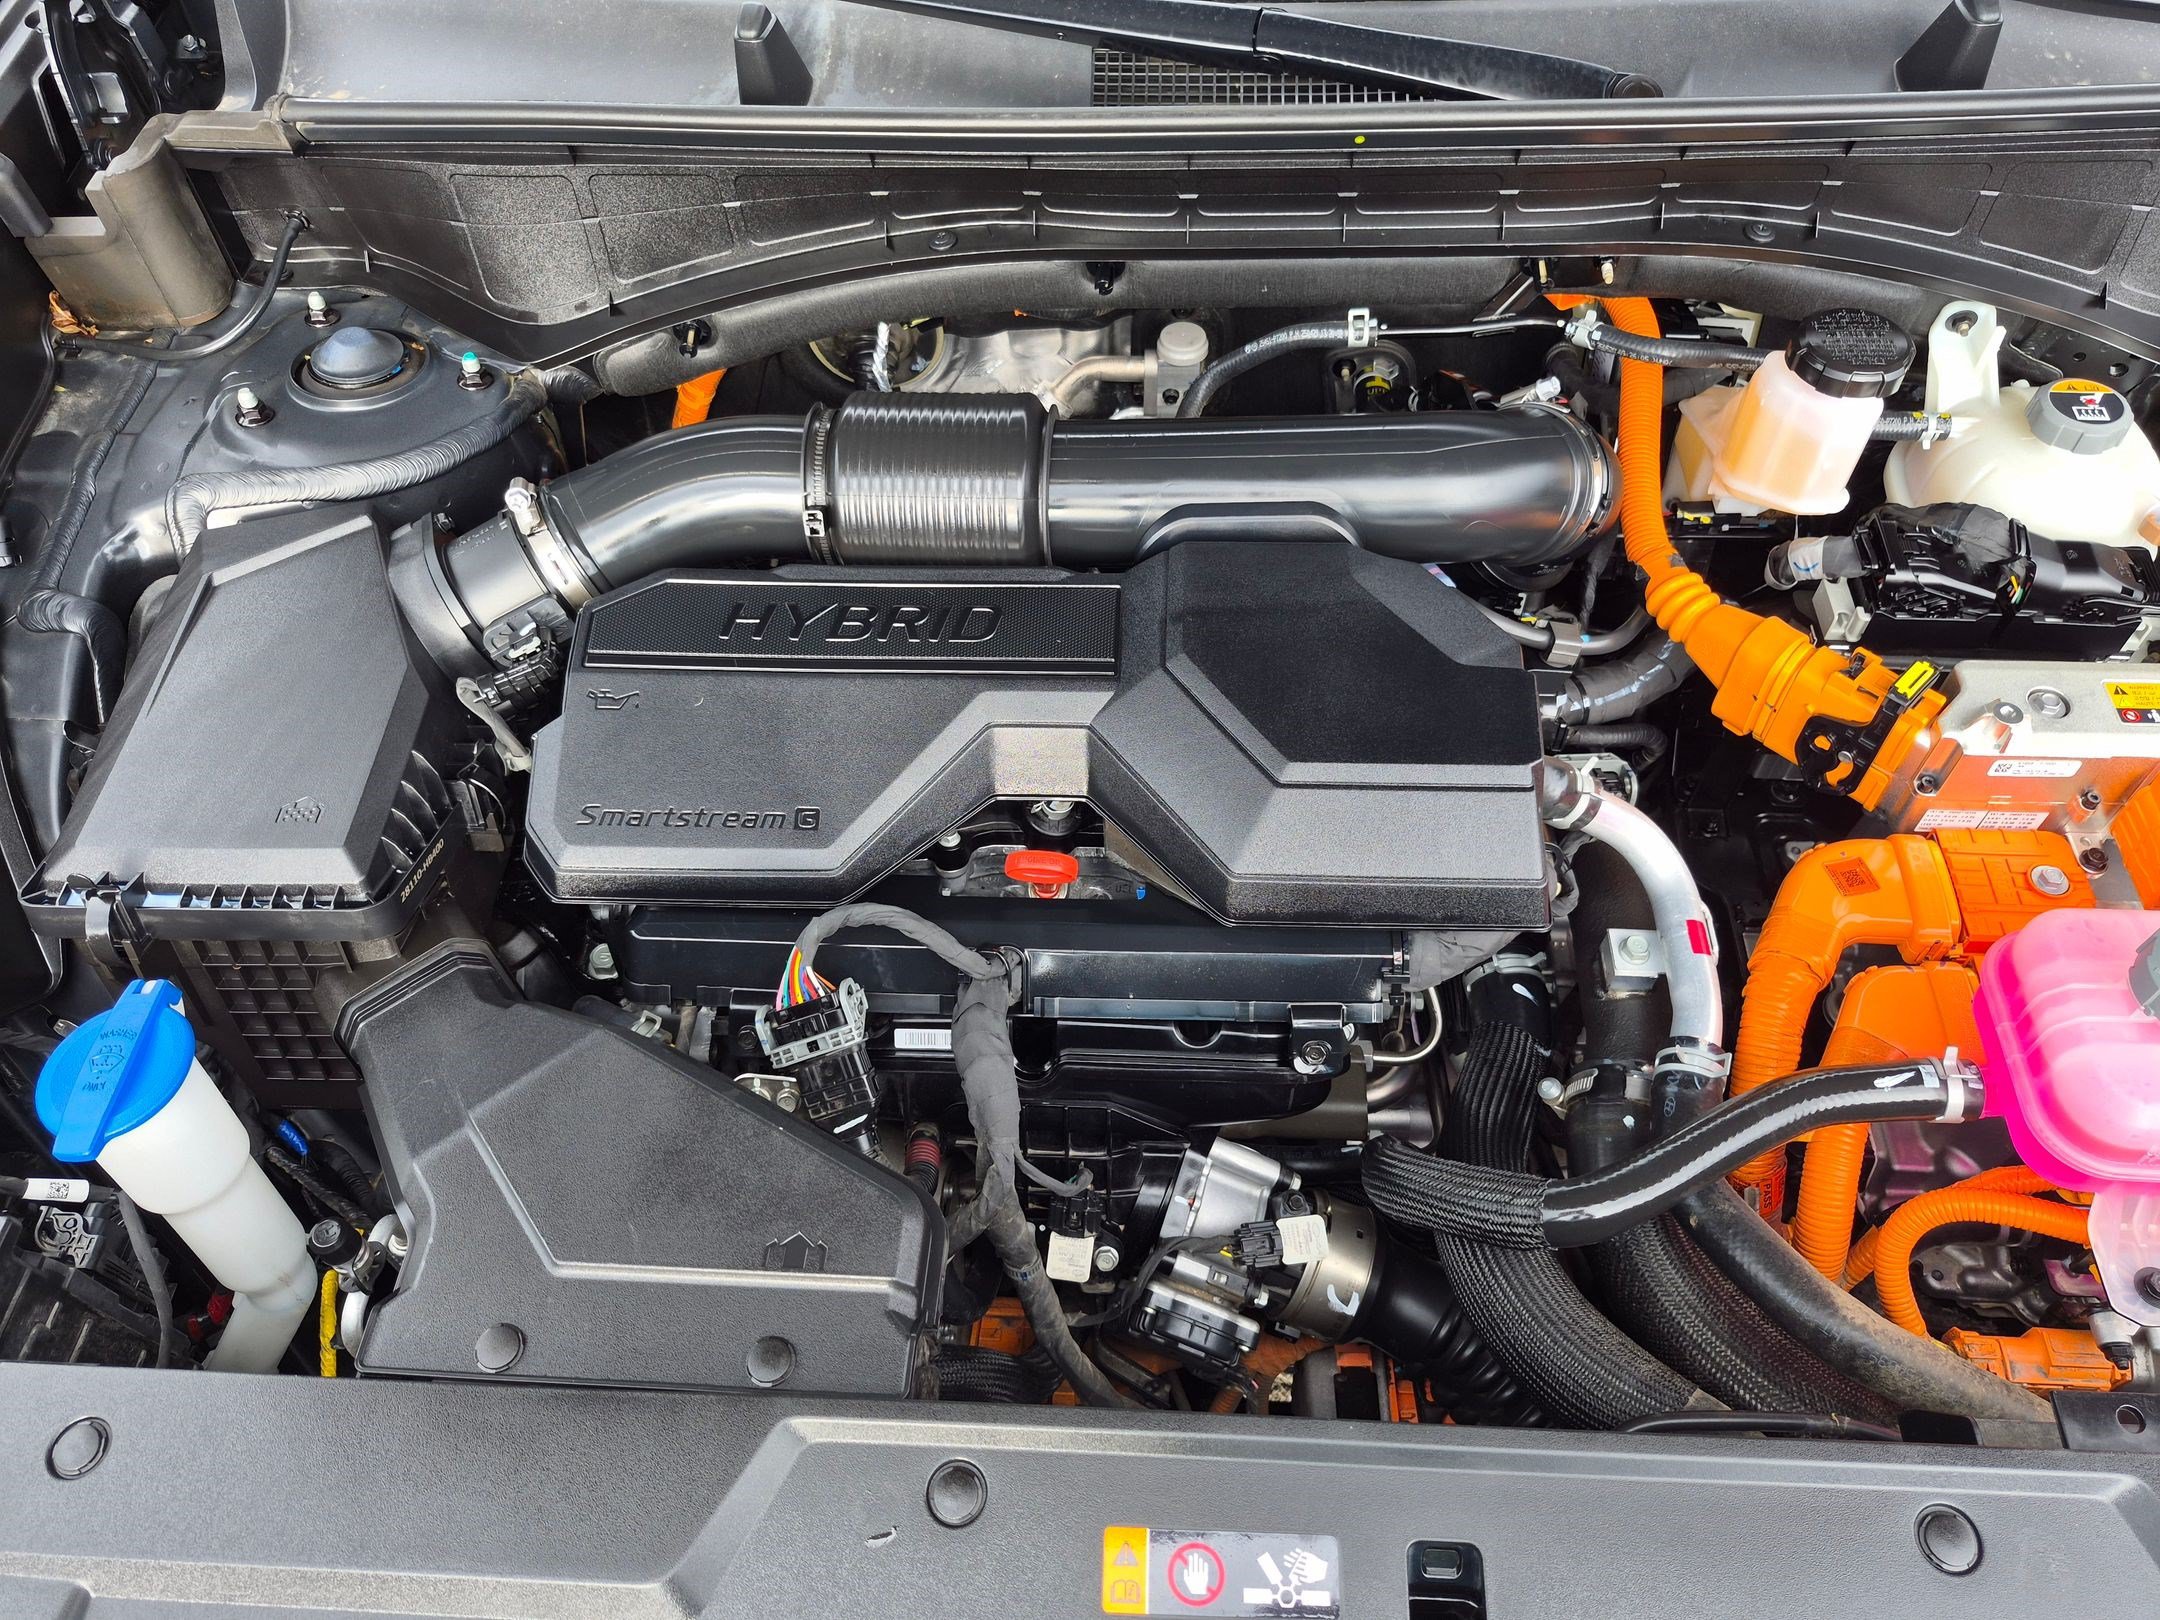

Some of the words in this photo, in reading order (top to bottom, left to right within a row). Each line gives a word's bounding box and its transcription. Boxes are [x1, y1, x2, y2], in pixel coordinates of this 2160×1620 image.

[719, 602, 1003, 642] HYBRID
[576, 803, 787, 827] Smartstream
[793, 806, 821, 830] G
[1763, 1183, 1772, 1209] PASS
